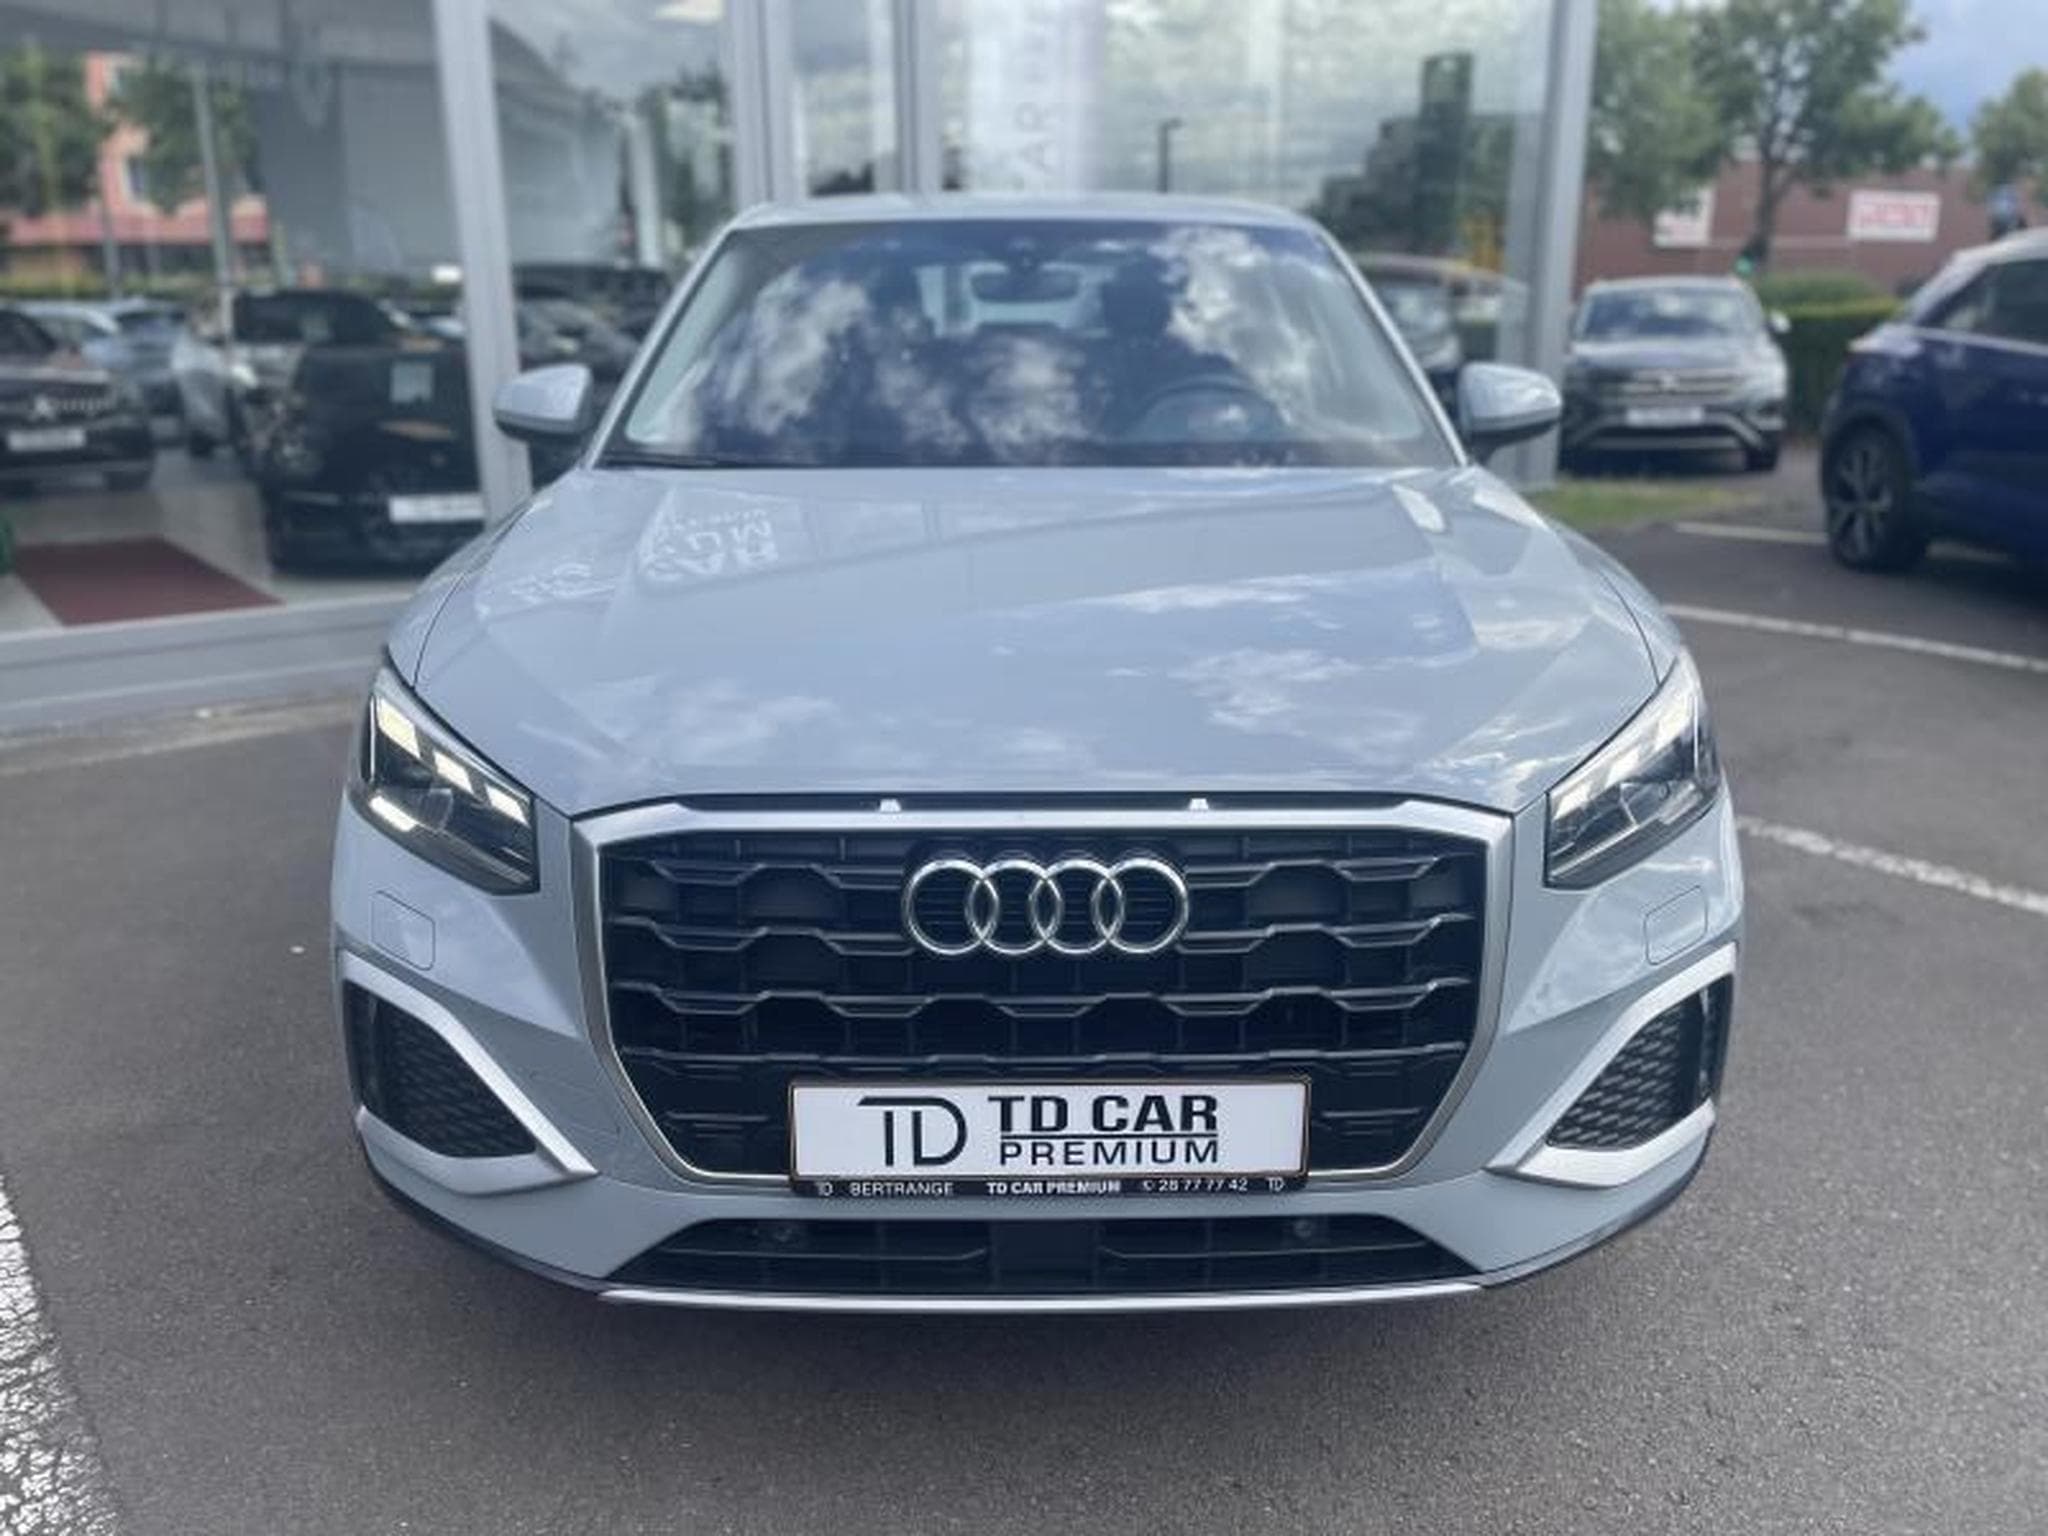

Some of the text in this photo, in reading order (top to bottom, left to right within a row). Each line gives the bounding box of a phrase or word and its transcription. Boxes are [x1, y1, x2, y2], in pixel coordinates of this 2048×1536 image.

[988, 1095, 1219, 1133] TD CAR
[1000, 1139, 1219, 1166] PREMIUM
[849, 1181, 955, 1197] BERTRANGE
[986, 1181, 1008, 1195] TD
[1010, 1181, 1044, 1195] CAR
[1046, 1180, 1120, 1195] PREMIUM
